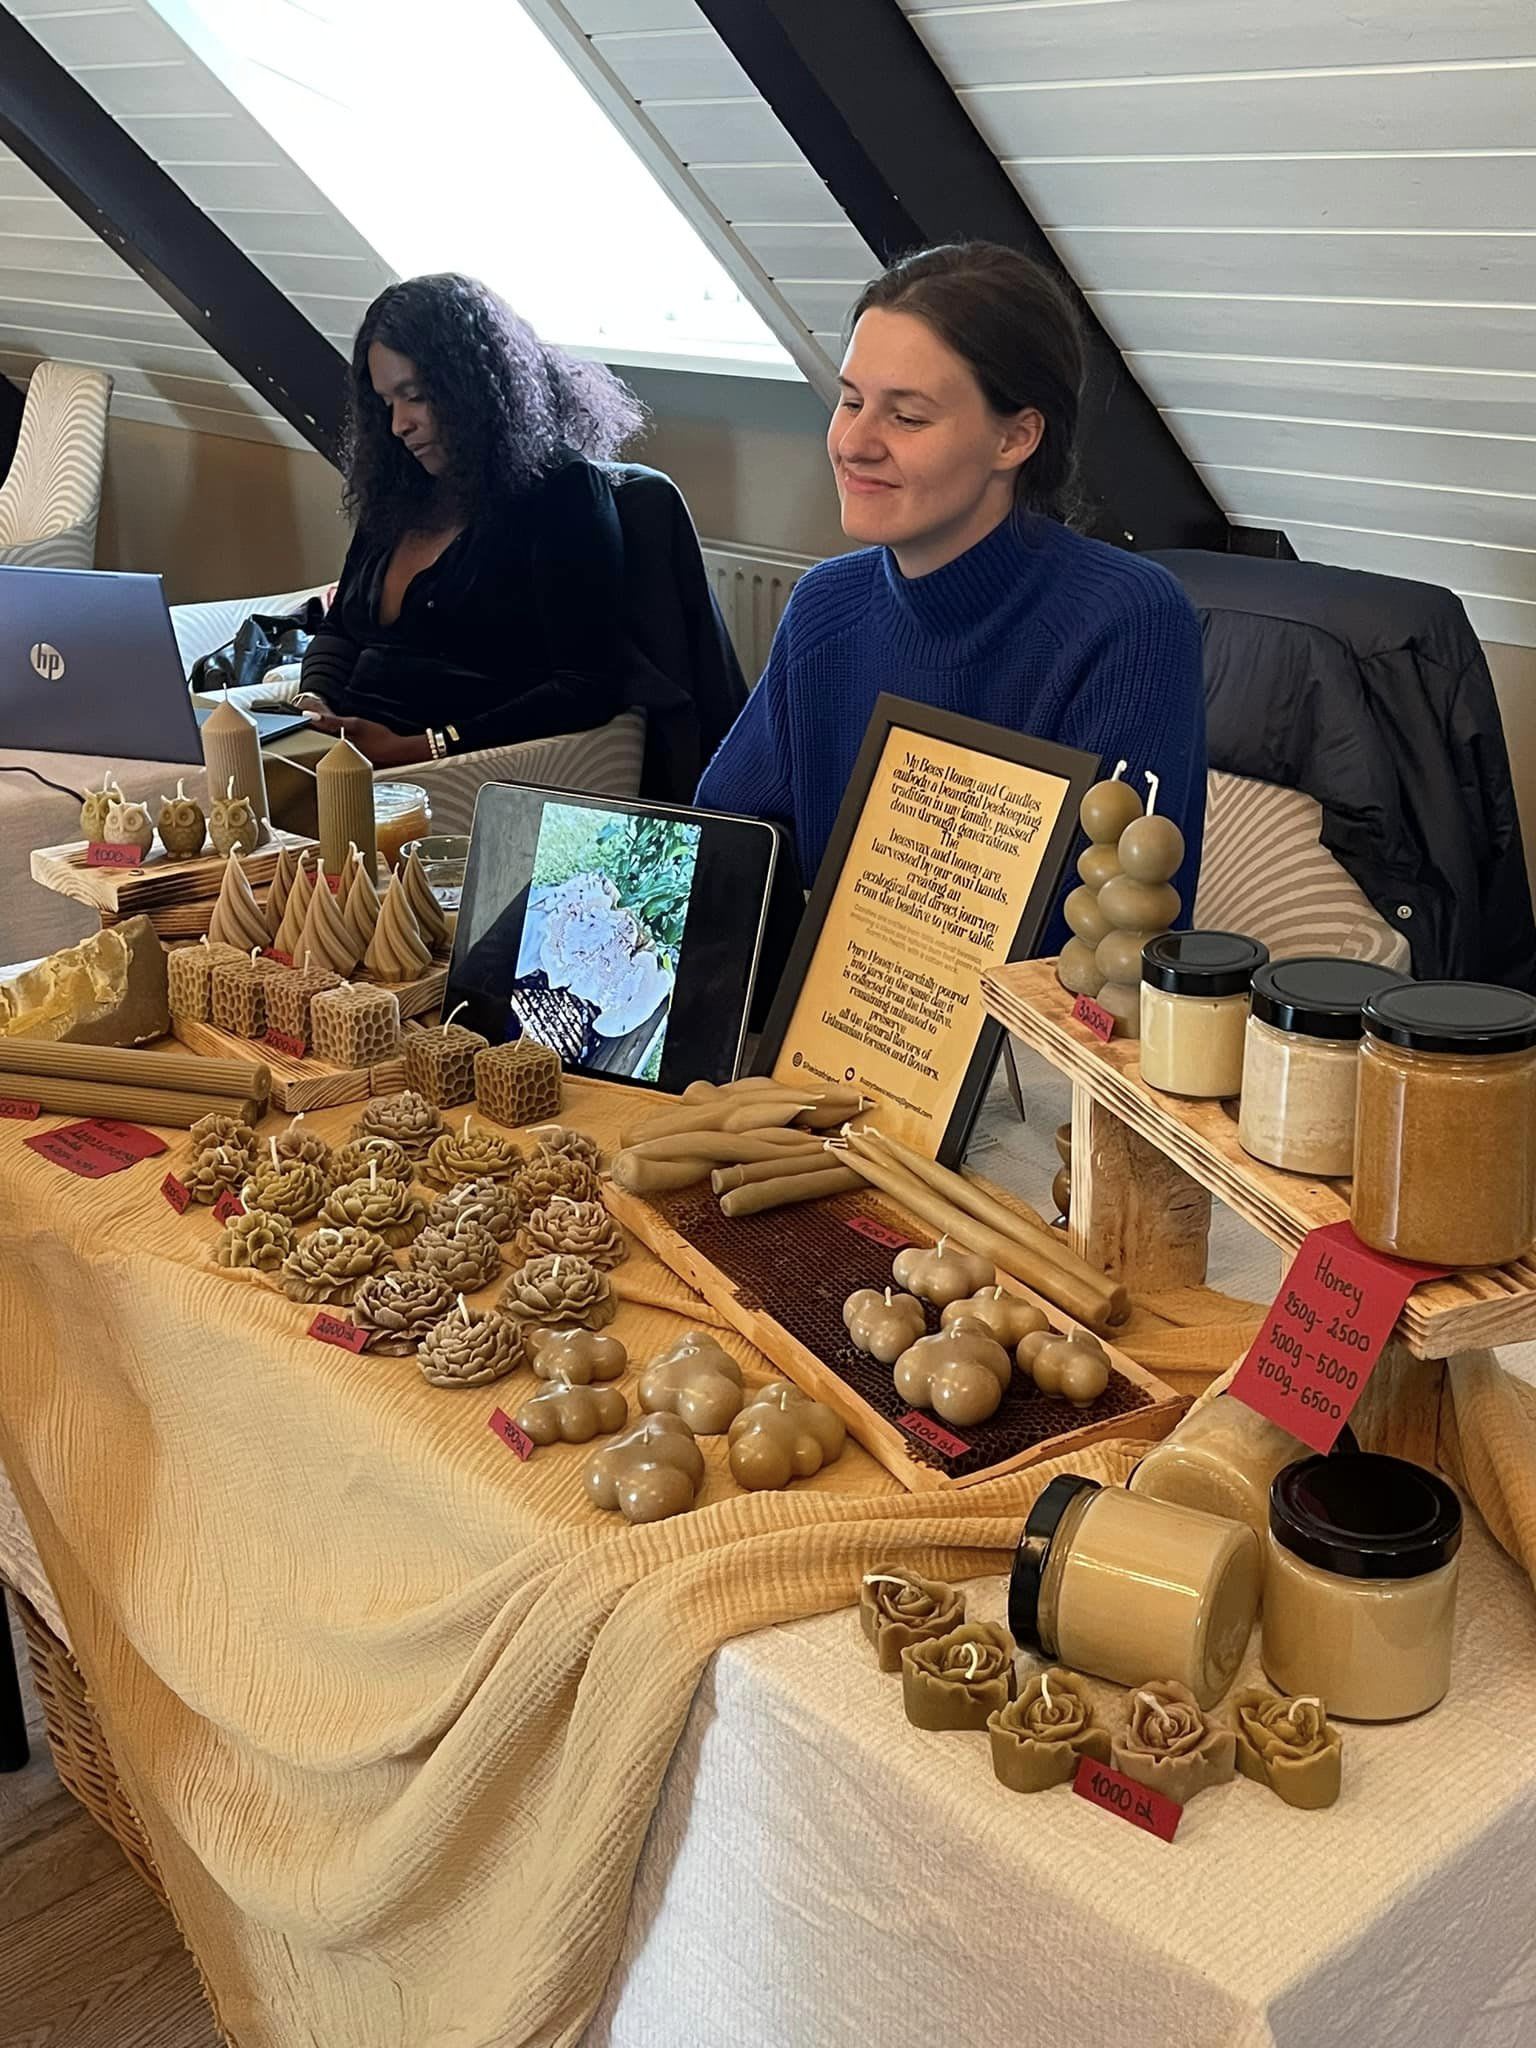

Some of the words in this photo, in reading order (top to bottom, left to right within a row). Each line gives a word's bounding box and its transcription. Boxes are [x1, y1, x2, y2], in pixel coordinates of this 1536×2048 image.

[34, 642, 62, 680] hp
[903, 752, 920, 769] My
[919, 758, 944, 778] Bees
[944, 766, 977, 789] Honey
[976, 782, 999, 797] and
[999, 785, 1042, 812] Candles
[889, 828, 931, 856] beeswax
[930, 848, 952, 864] and
[950, 852, 982, 875] honey
[982, 868, 1001, 883] are
[1314, 1252, 1364, 1318] Honey
[1090, 1771, 1132, 1811] 1000
